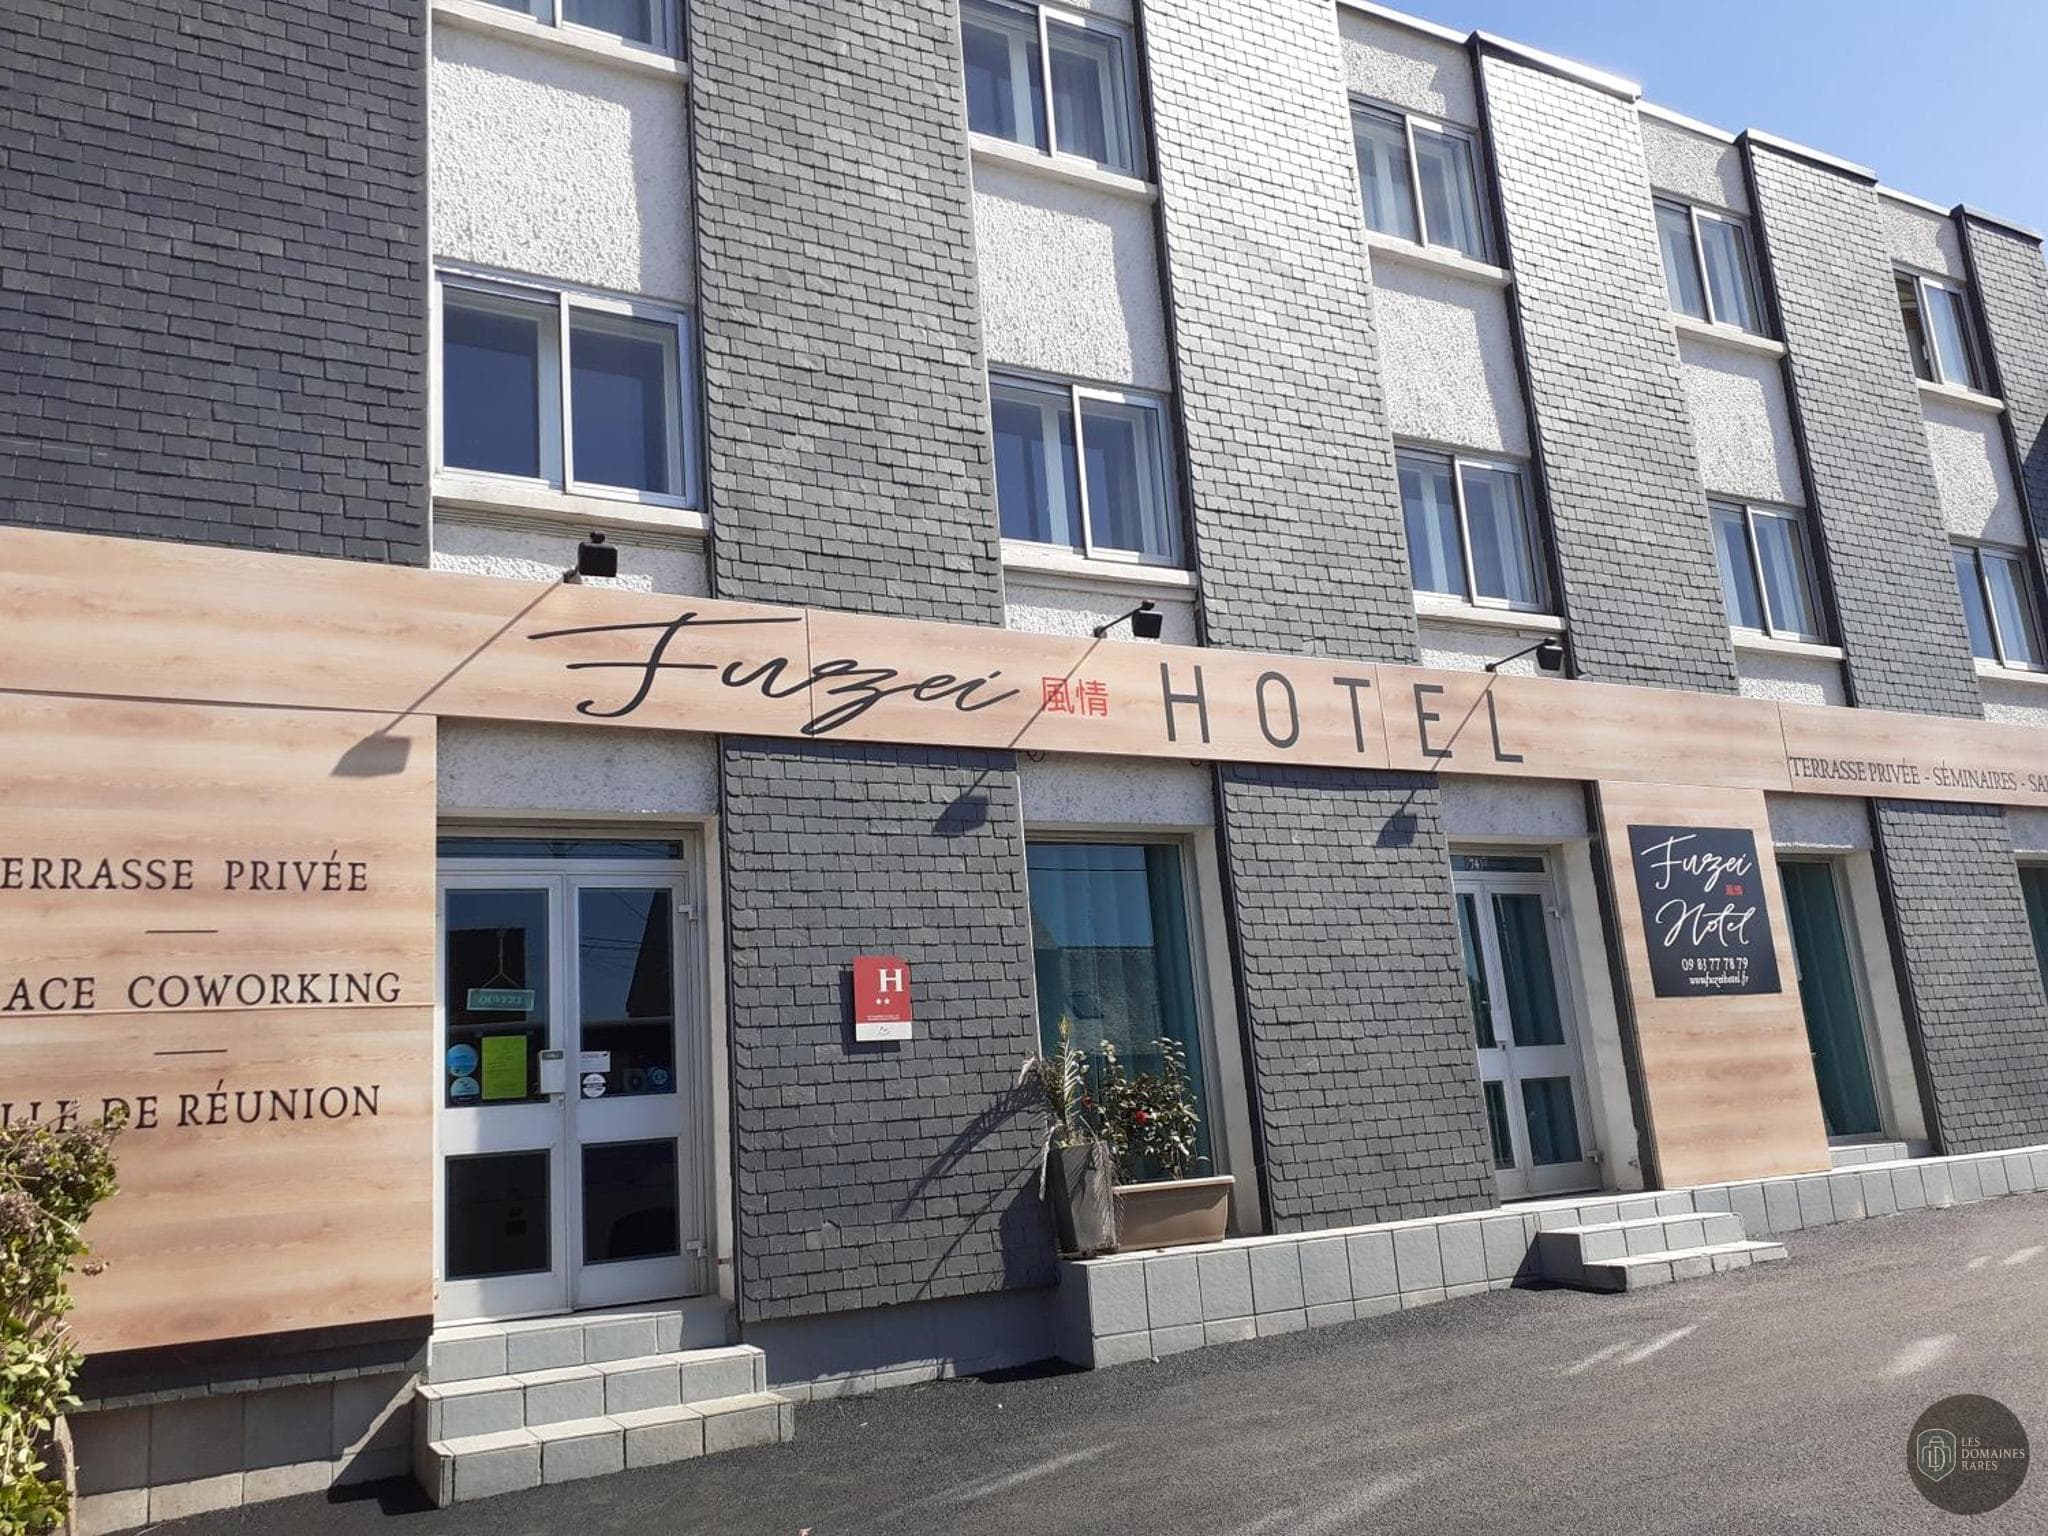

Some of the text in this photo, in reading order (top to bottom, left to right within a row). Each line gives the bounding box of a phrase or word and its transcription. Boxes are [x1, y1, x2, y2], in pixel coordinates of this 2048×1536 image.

[528, 612, 1021, 735] Fuzei
[1042, 677, 1109, 716] 風情
[1160, 661, 1523, 763] HOTEL
[1789, 757, 1867, 781] TERRASSE
[1868, 757, 1921, 785] PRIVÉE
[1932, 760, 2017, 791] SÉMINAIRES
[224, 850, 368, 892] PRIVÉE
[1640, 834, 1752, 893] Fuzei
[878, 968, 905, 992] H
[1681, 957, 1694, 971] 09
[1708, 957, 1721, 971] 77
[1736, 956, 1749, 970] 79
[128, 972, 401, 1008] COWORKING
[102, 1096, 159, 1131] DE
[177, 1079, 380, 1128] RÉUNION
